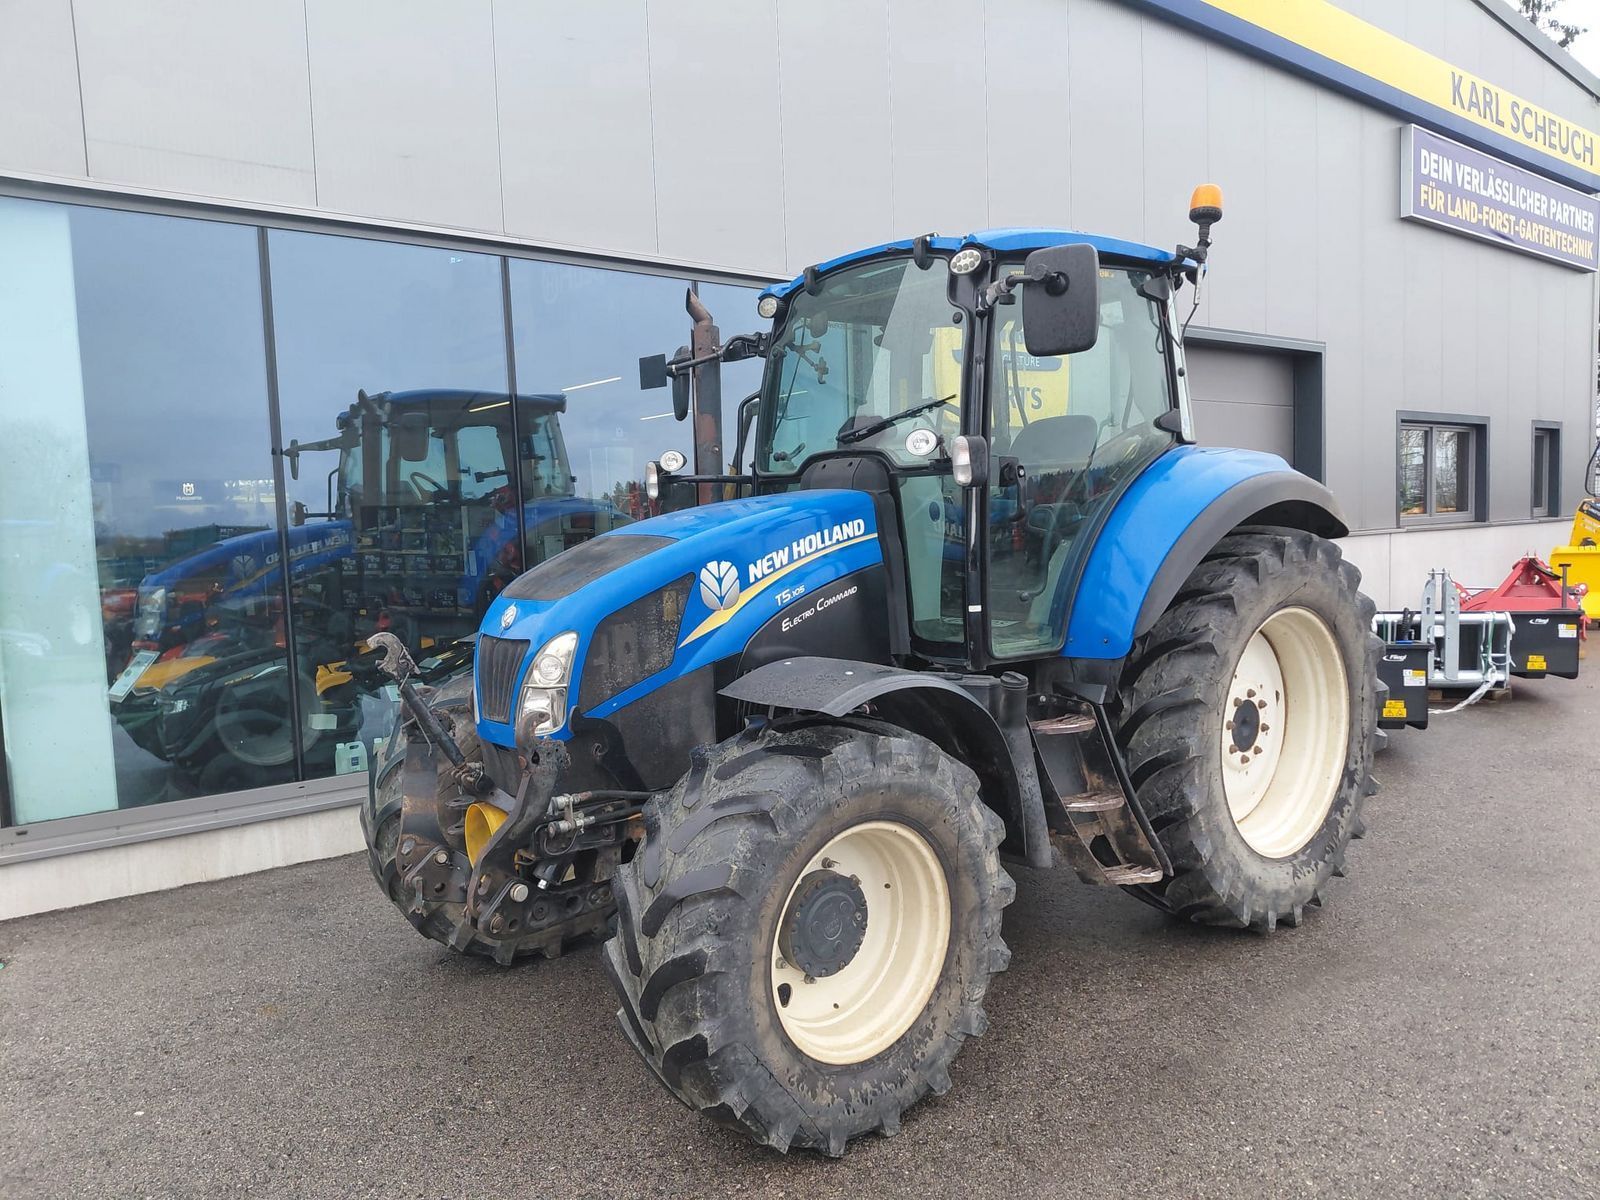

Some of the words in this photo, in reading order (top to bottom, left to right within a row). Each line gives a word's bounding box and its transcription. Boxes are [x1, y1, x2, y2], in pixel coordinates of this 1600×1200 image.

[1451, 71, 1504, 128] KARL
[1510, 101, 1594, 166] SCHEUCH
[1420, 148, 1453, 185] DEIN
[1455, 167, 1548, 218] VERLÄSSLICHER
[1549, 197, 1594, 234] PARTNER
[1420, 182, 1445, 214] FÜR
[1447, 193, 1593, 260] LAND-FORST-GARTENTECHNIK
[748, 544, 789, 583] NEW
[792, 518, 865, 560] HOLLAND
